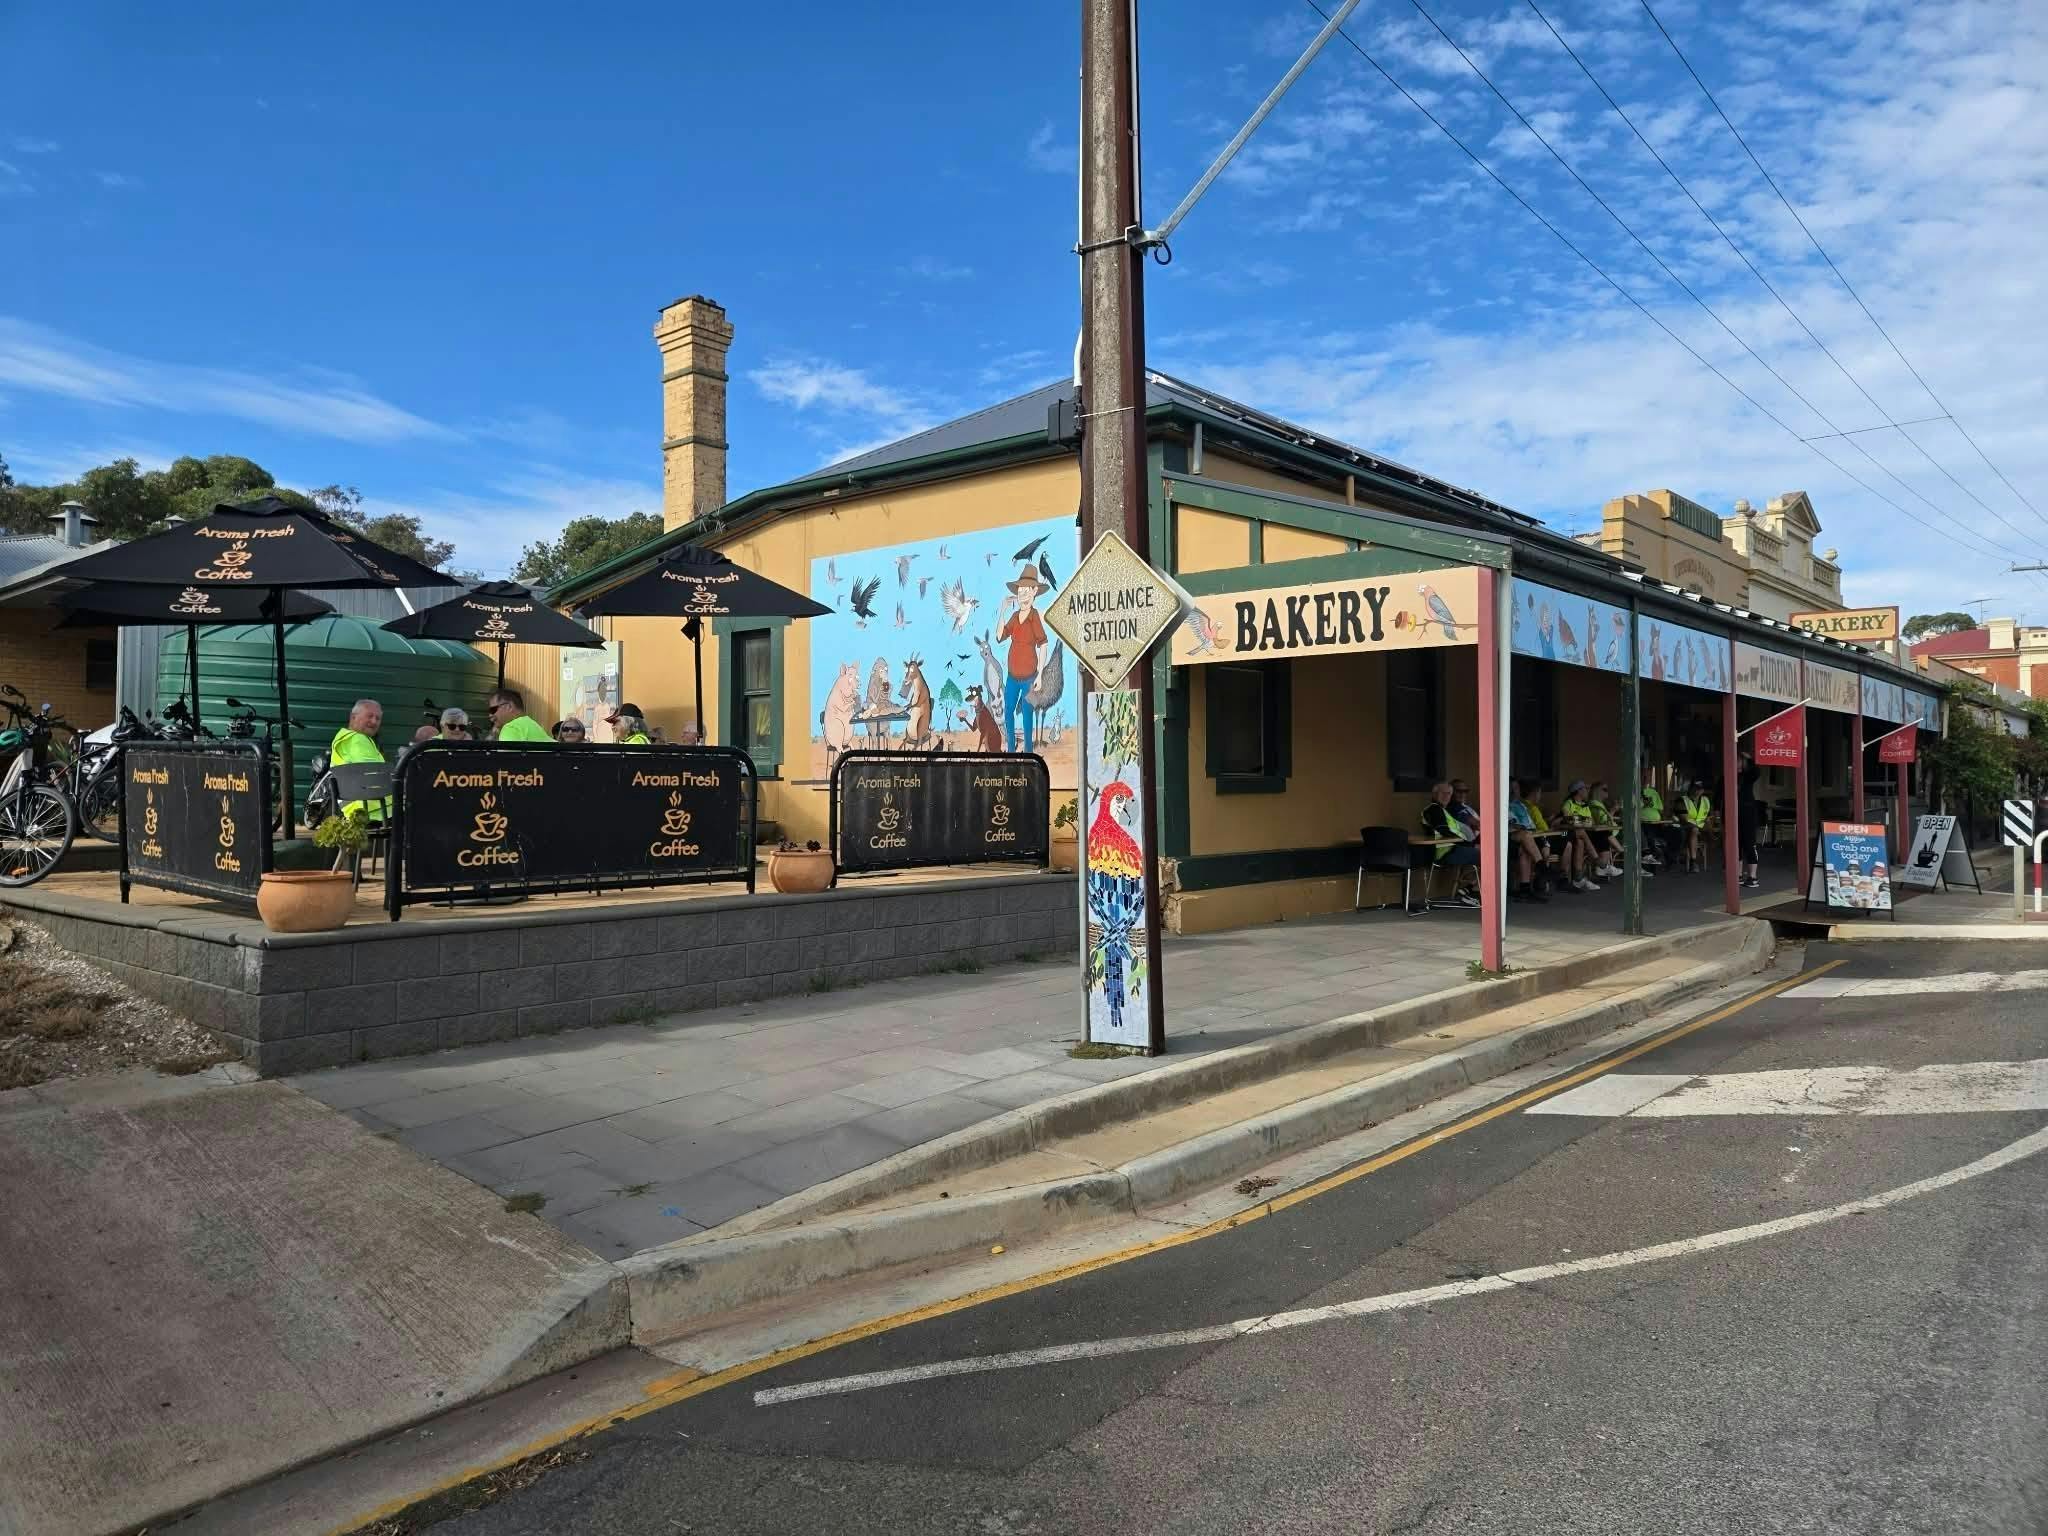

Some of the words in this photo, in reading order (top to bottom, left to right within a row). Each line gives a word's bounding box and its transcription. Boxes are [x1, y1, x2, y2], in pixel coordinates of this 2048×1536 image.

[194, 526, 249, 539] Aroma
[252, 524, 295, 539] Fresh
[194, 568, 253, 580] Coffee
[661, 570, 703, 584] Aroma
[704, 572, 739, 584] Fresh
[463, 600, 500, 612] Aroma
[502, 603, 533, 613] Fresh
[1068, 586, 1154, 615] AMBULANCE
[169, 604, 222, 614] Coffee
[684, 604, 730, 613] Coffee
[1235, 587, 1390, 652] BAKERY
[1800, 615, 1889, 633] BAKERY
[475, 630, 516, 639] Coffee
[1083, 618, 1138, 642] STATION
[1760, 655, 1799, 699] EUDUNDA
[1805, 666, 1832, 704] BAKERY
[1759, 748, 1798, 758] COFFEE
[133, 767, 151, 784] Aroma
[151, 766, 169, 785] Fresh
[204, 772, 226, 791] Aroma
[227, 771, 249, 792] Fresh
[433, 769, 493, 788] Aroma
[497, 768, 544, 787] Fresh
[632, 771, 680, 787] Aroma
[682, 770, 720, 787] Fresh
[856, 776, 891, 789] Aroma
[893, 774, 921, 789] Fresh
[973, 775, 1002, 788] Aroma
[1004, 774, 1028, 788] Fresh
[1839, 824, 1869, 835] OPEN
[1922, 817, 1952, 830] OPEN
[870, 832, 907, 849] Coffee
[985, 828, 1016, 842] Coffee
[141, 838, 162, 857] Coffee
[650, 839, 699, 857] Coffee
[1832, 843, 1858, 852] Grab
[215, 851, 241, 873] Coffee
[457, 846, 520, 866] Coffee
[1841, 851, 1871, 863] today
